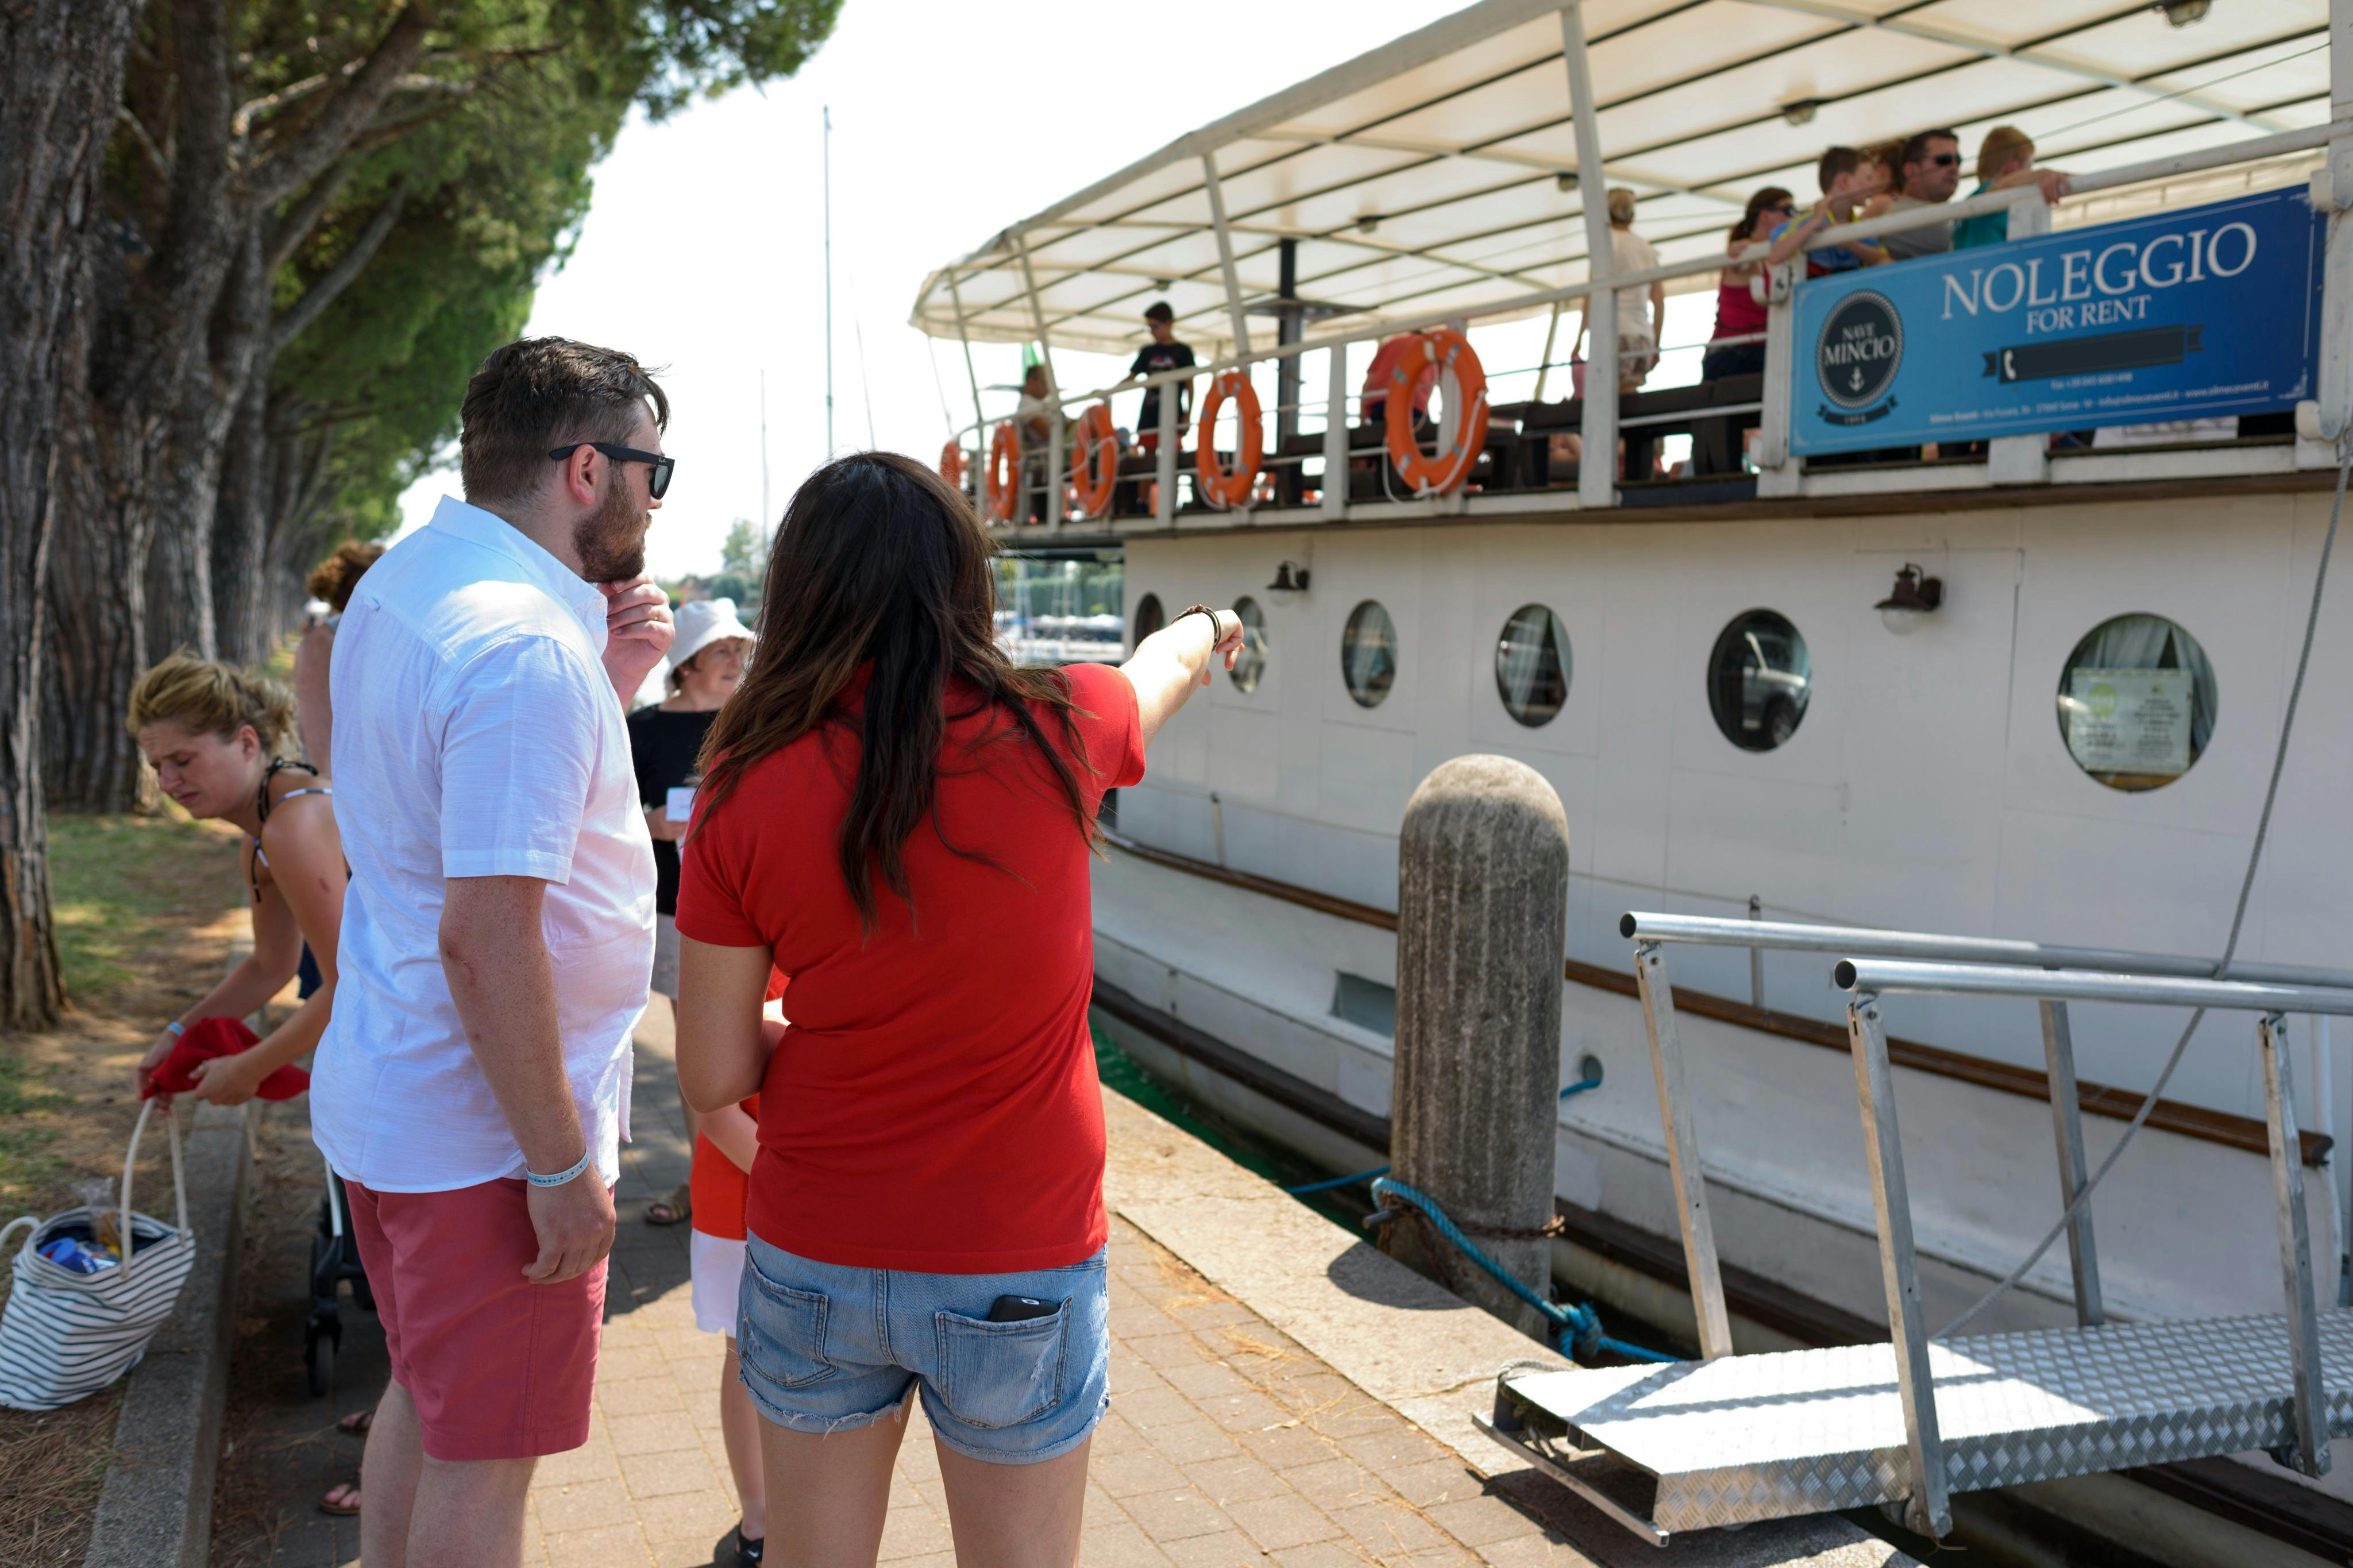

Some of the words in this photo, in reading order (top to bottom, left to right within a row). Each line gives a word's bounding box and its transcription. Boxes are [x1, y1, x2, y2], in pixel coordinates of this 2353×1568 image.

[1941, 222, 2256, 319] NOLEGGIO
[1842, 321, 1875, 341] NAVE
[2026, 308, 2073, 334] FOR
[2080, 295, 2151, 327] RENT
[1823, 334, 1895, 365] MINCIO
